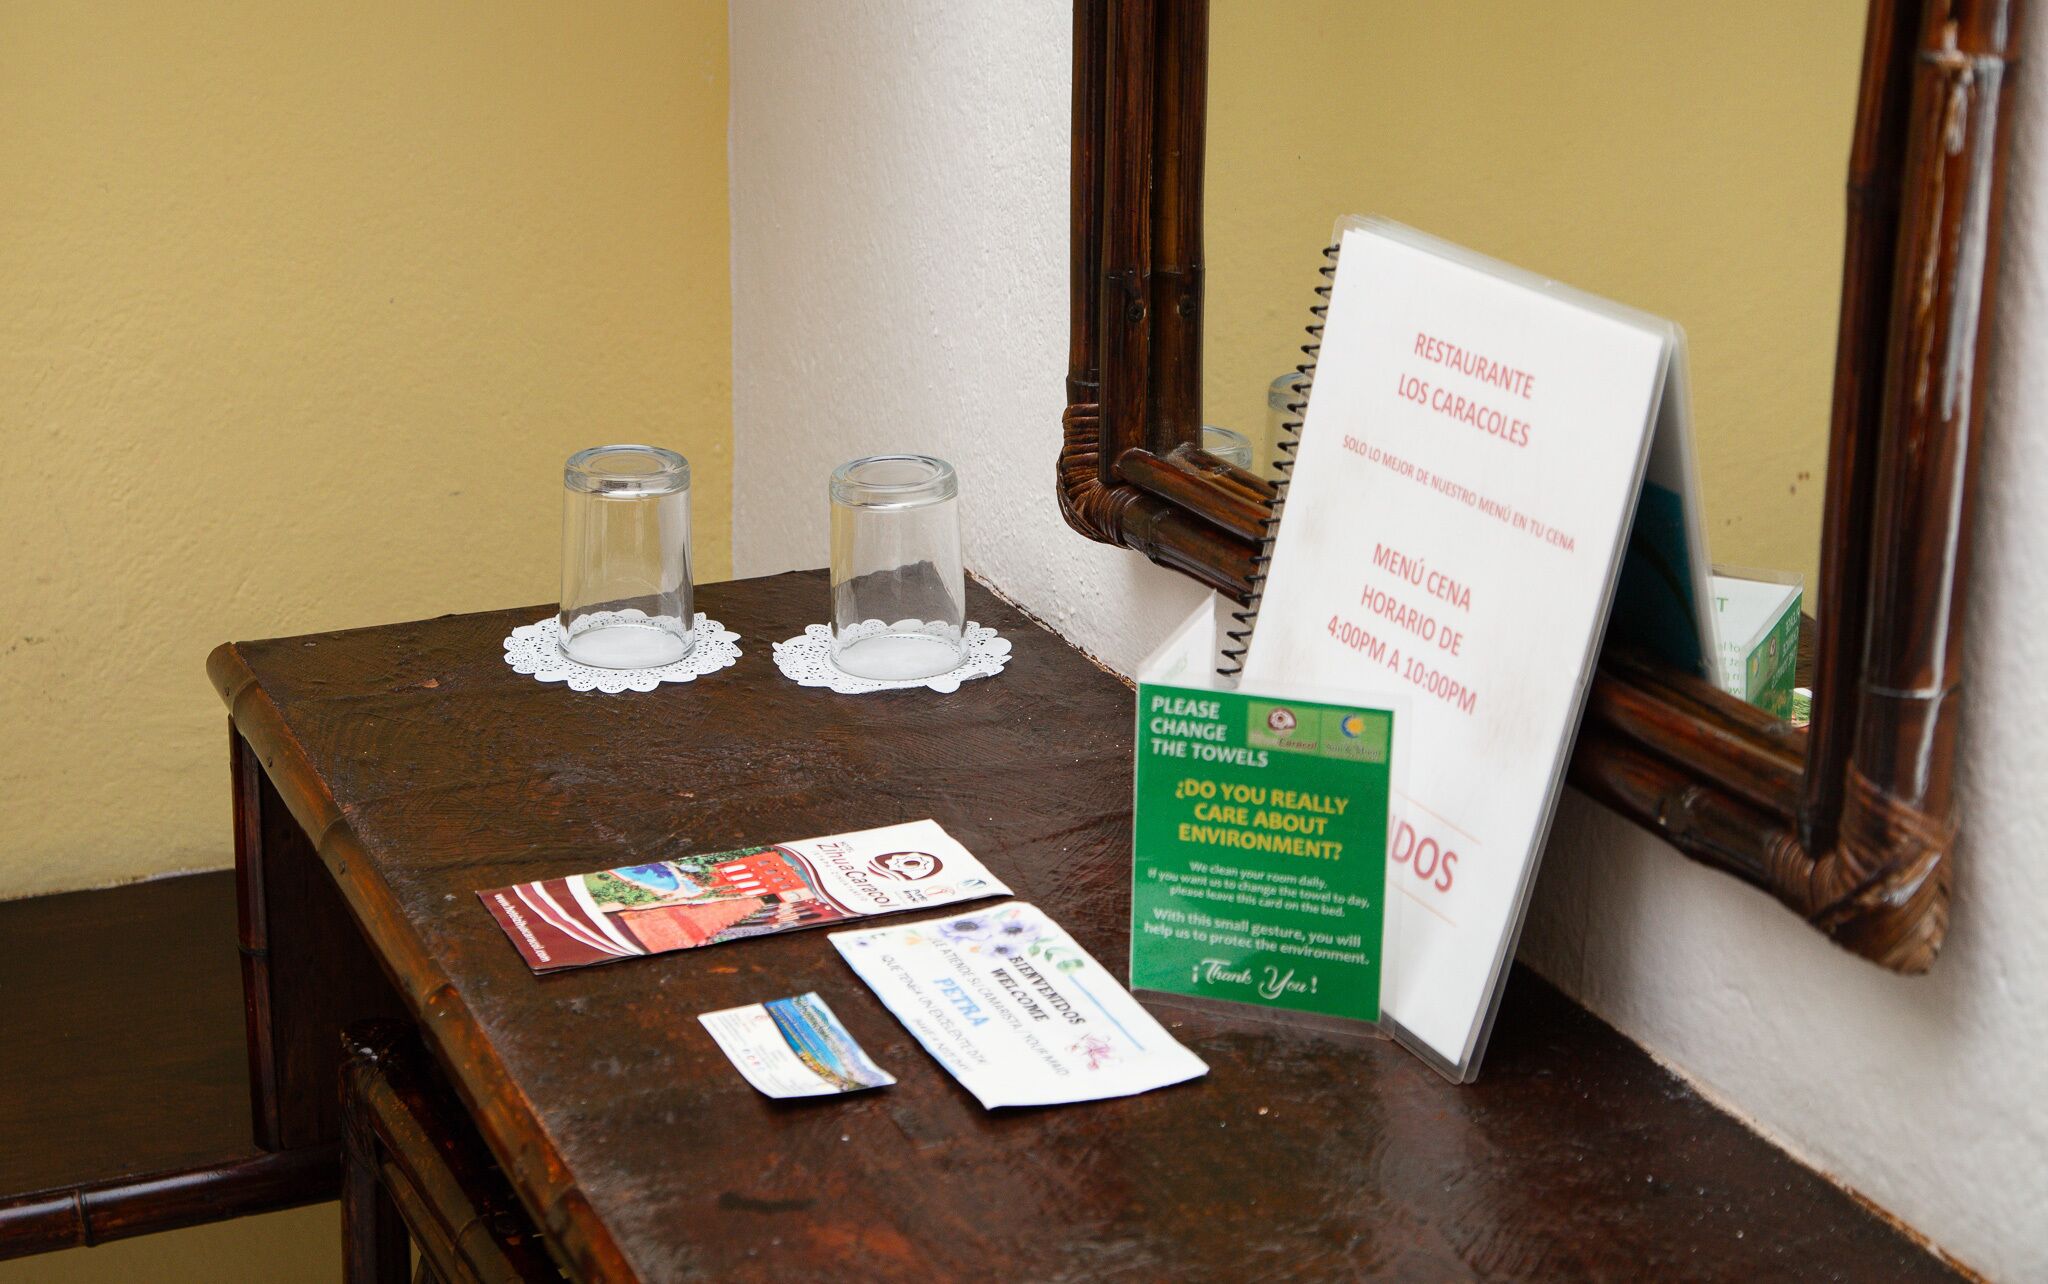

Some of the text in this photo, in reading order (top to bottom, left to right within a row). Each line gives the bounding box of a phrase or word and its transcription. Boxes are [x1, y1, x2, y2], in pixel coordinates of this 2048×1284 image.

[1414, 332, 1535, 399] RESTAURANTE
[1398, 374, 1530, 447] LOS CARACOLES
[1343, 434, 1576, 553] SOLO LO MEJOR DE NUESTRO MENÚ EN TU CENA
[1372, 542, 1473, 612] MENÚ CENA
[1361, 584, 1463, 657] HORARIO DE
[1327, 615, 1478, 715] 4:00PM A 10:00PM
[1151, 696, 1220, 719] PLEASE
[1151, 718, 1228, 742] CHANGE
[1151, 738, 1269, 768] THE TOWELS
[1175, 778, 1349, 815] ¿DO YOU REALLY
[1194, 802, 1328, 836] CARE ABOUT
[1178, 823, 1343, 861] ENVIRONMENT?
[1158, 870, 1179, 882] you
[1180, 874, 1207, 886] want
[1209, 878, 1222, 888] us
[1223, 878, 1236, 890] to
[1238, 881, 1277, 897] change
[1278, 885, 1297, 898] the
[1298, 889, 1331, 902] towel
[1332, 892, 1345, 904] to
[1188, 861, 1208, 873] We
[1209, 864, 1238, 877] clean
[1240, 868, 1265, 880] your
[1266, 872, 1297, 884] room
[1169, 884, 1205, 899] please
[1206, 889, 1235, 903] leave
[1236, 892, 1257, 906] this
[1258, 897, 1283, 909] card
[1284, 901, 1299, 911] on
[1300, 901, 1320, 914] the
[1144, 921, 1173, 938] help
[1175, 928, 1190, 939] us
[1192, 928, 1207, 941] to
[1255, 938, 1277, 952] the
[1280, 943, 1370, 965] environment.
[1152, 908, 1361, 948] With this small gesture, you will
[933, 977, 990, 1027] PETRA
[990, 967, 1050, 1022] WELCOME
[1009, 955, 1086, 1025] BIENVENIDOS
